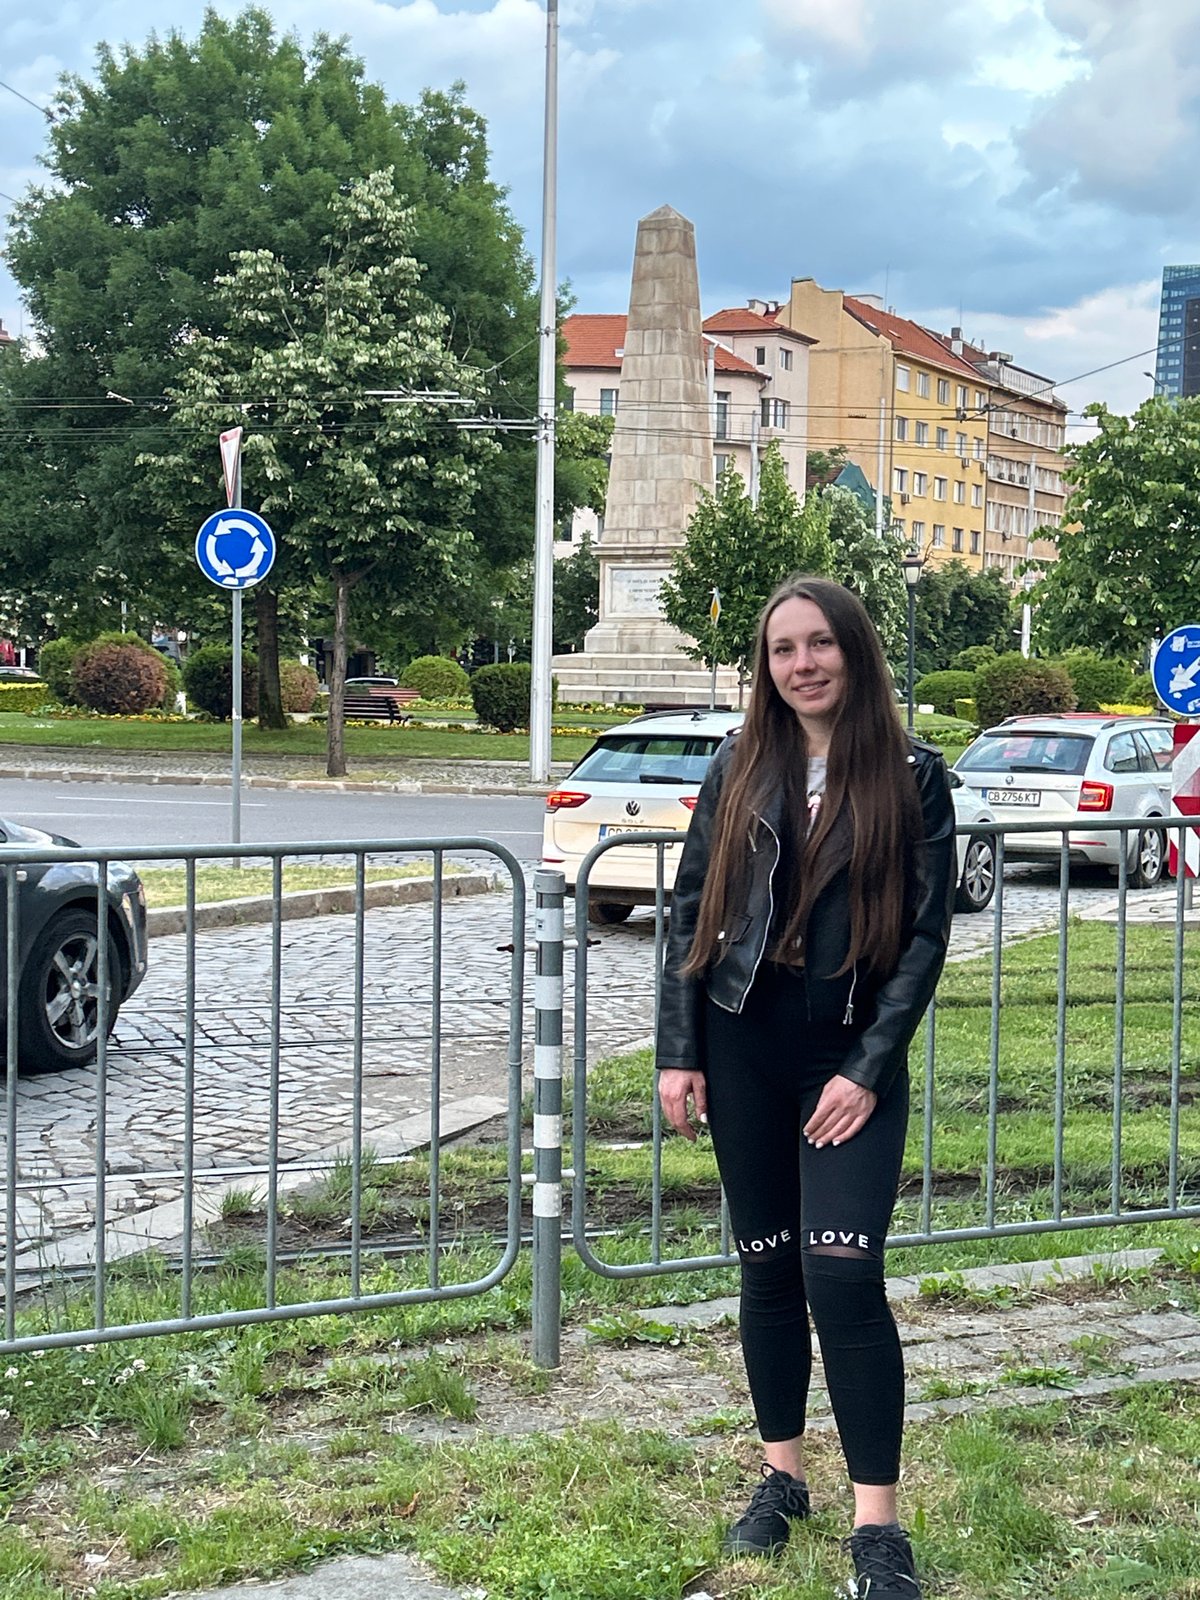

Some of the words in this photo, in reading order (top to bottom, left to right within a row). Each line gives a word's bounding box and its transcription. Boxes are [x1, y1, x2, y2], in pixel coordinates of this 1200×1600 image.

[988, 791, 1000, 801] CB
[1001, 792, 1024, 802] 2756
[1025, 793, 1038, 802] KT
[739, 1229, 791, 1252] LOVE
[809, 1230, 869, 1249] LOVE
